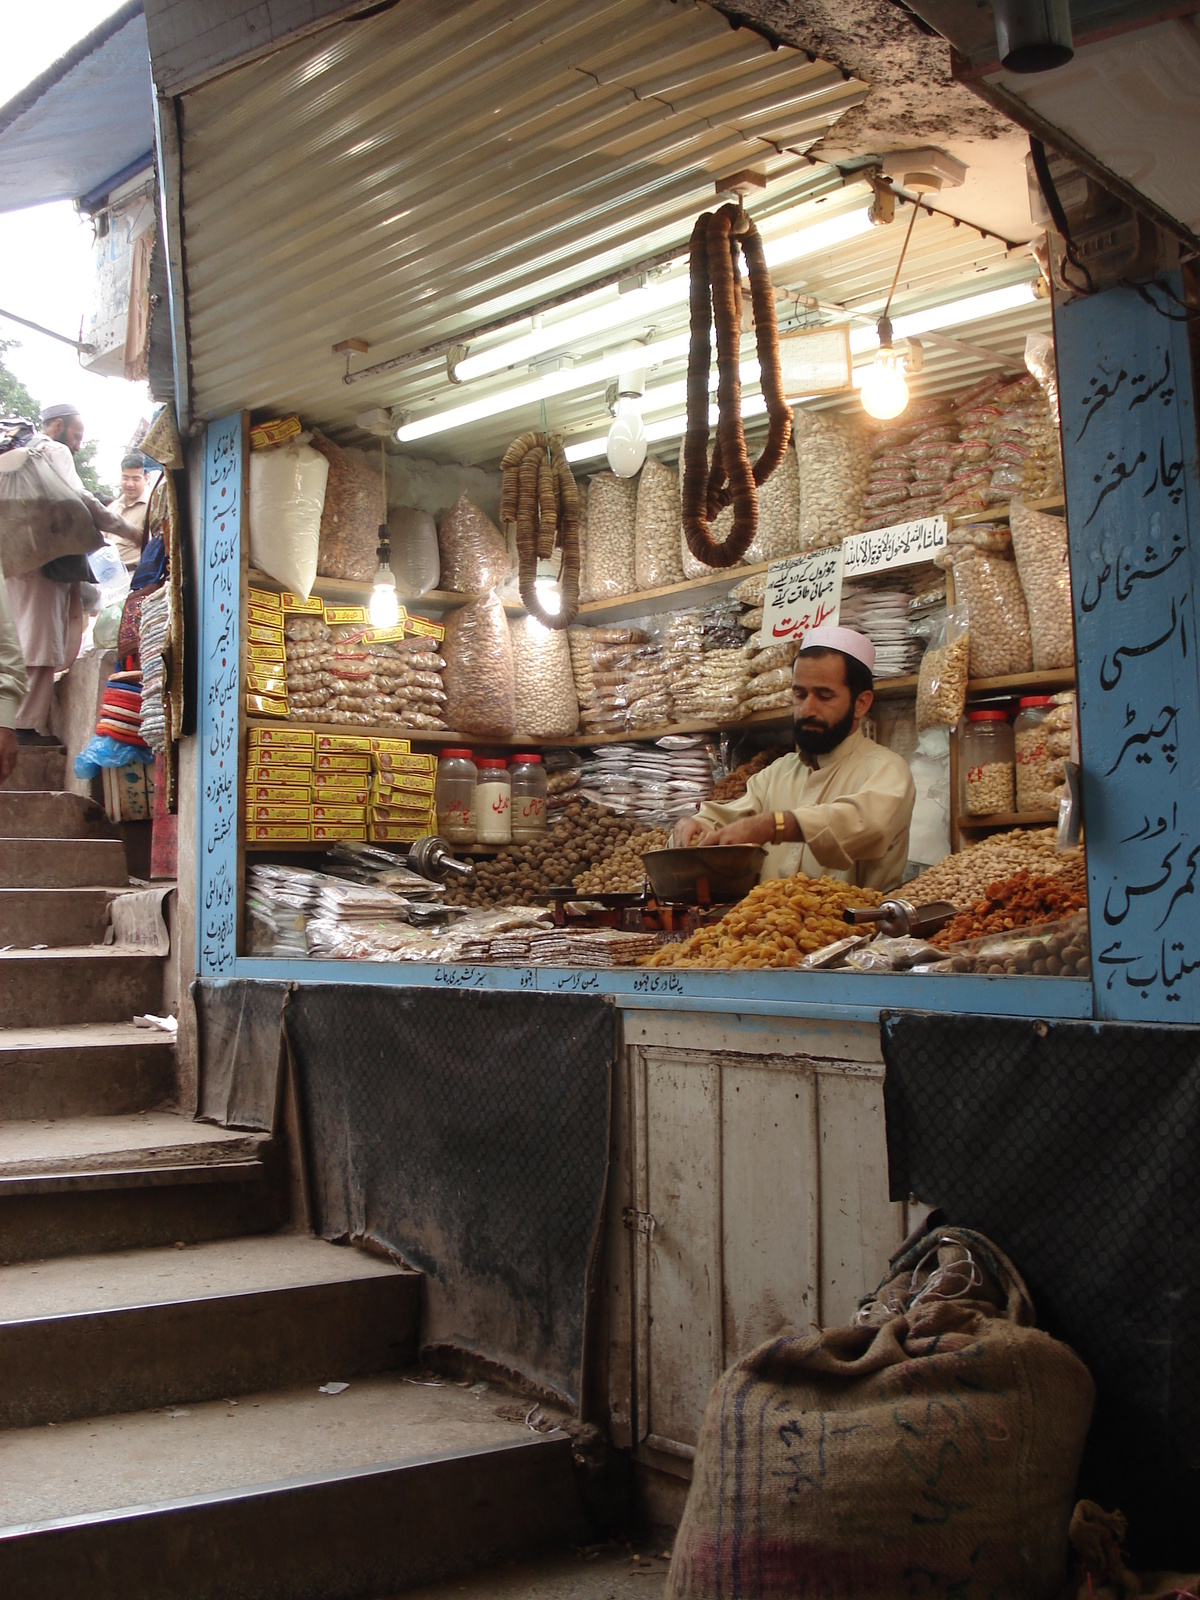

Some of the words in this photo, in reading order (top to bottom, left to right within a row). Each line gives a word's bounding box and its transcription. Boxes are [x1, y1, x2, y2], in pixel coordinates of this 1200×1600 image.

[1128, 350, 1175, 411] پستہ
[1074, 369, 1128, 444] مغز
[1142, 436, 1185, 505] چار
[212, 488, 237, 523] پستہ
[1082, 450, 1147, 529] مغز
[212, 566, 233, 603] بادام
[808, 560, 837, 581] جوڑوں
[787, 584, 809, 604] طاقت
[809, 580, 834, 602] جسمانی
[210, 608, 236, 660] انجیر
[207, 672, 225, 707] کاجو
[219, 663, 238, 707] نمکین
[209, 717, 235, 757] خوبانی
[205, 769, 234, 805] چلغوزہ
[492, 792, 510, 815] ناریل
[1119, 800, 1178, 844] اور
[216, 859, 227, 876] اور
[209, 943, 234, 973] دستیاب
[1097, 939, 1144, 991] ہے
[1126, 937, 1200, 1002] ستیاب
[473, 971, 488, 986] سبز
[520, 970, 534, 988] قہوہ
[557, 971, 582, 990] گراس
[581, 972, 599, 990] لیمن
[633, 972, 649, 992] قہوہ
